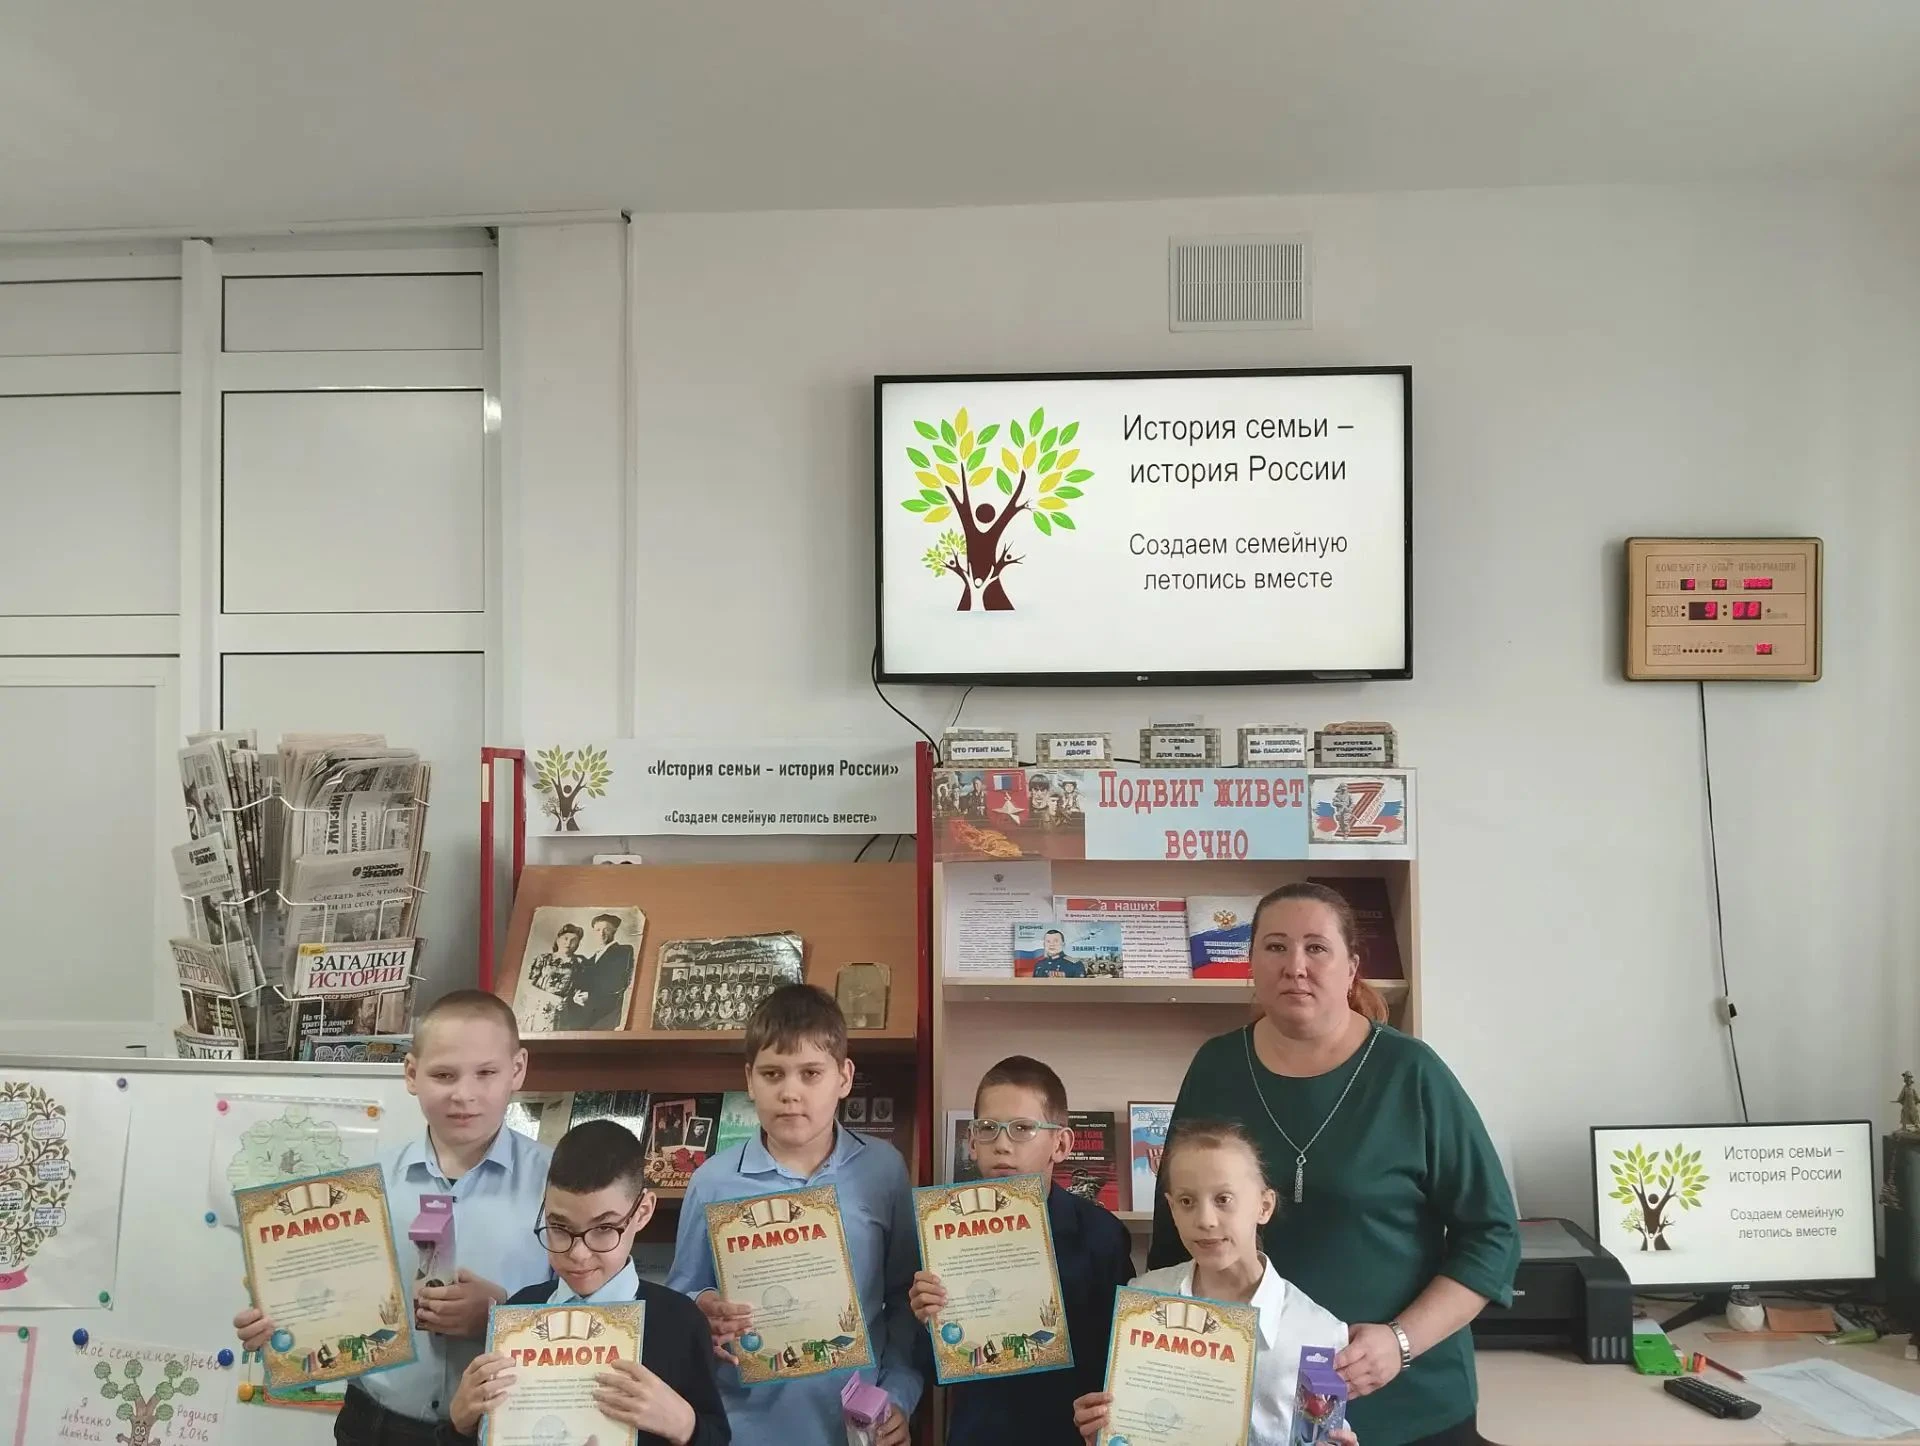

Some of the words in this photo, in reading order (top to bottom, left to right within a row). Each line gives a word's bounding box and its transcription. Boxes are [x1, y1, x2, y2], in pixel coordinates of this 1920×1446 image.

[1123, 414, 1236, 446] История
[1245, 416, 1328, 438] семьи
[1130, 460, 1239, 489] история
[1248, 455, 1347, 482] России
[1129, 534, 1228, 559] Создаем
[1235, 531, 1348, 558] семейную
[1144, 571, 1246, 591] летопись
[1254, 569, 1333, 588] вместе
[1065, 749, 1091, 757] ДВОРЕ
[648, 759, 713, 780] «История
[718, 763, 760, 776] семьи
[779, 763, 834, 780] история
[839, 759, 899, 777] России»
[1099, 771, 1204, 814] Подвиг
[1213, 775, 1304, 808] живет
[327, 794, 345, 844] ЖИЗНИ
[664, 810, 718, 827] «Создаем
[721, 810, 776, 826] семейную
[779, 812, 829, 825] летопись
[833, 812, 878, 823] вместе»
[1165, 827, 1248, 860] вечно
[1114, 900, 1160, 911] наших!
[311, 951, 407, 973] ЗАГАДКИ
[308, 966, 405, 989] ИСТОРИИ
[1724, 1145, 1784, 1163] История
[1788, 1145, 1832, 1159] семьи
[1729, 1169, 1786, 1185] история
[1791, 1166, 1842, 1181] России
[1730, 1207, 1782, 1222] Создаем
[1786, 1205, 1844, 1221] семейную
[260, 1207, 370, 1243] ГРАМОТА
[934, 1214, 1031, 1240] ГРАМОТА
[1738, 1227, 1793, 1239] летопись
[1796, 1225, 1837, 1238] вместе
[726, 1223, 827, 1253] ГРАМОТА
[511, 1345, 620, 1367] ГРАМОТА
[1129, 1328, 1235, 1363] ГРАМОТА
